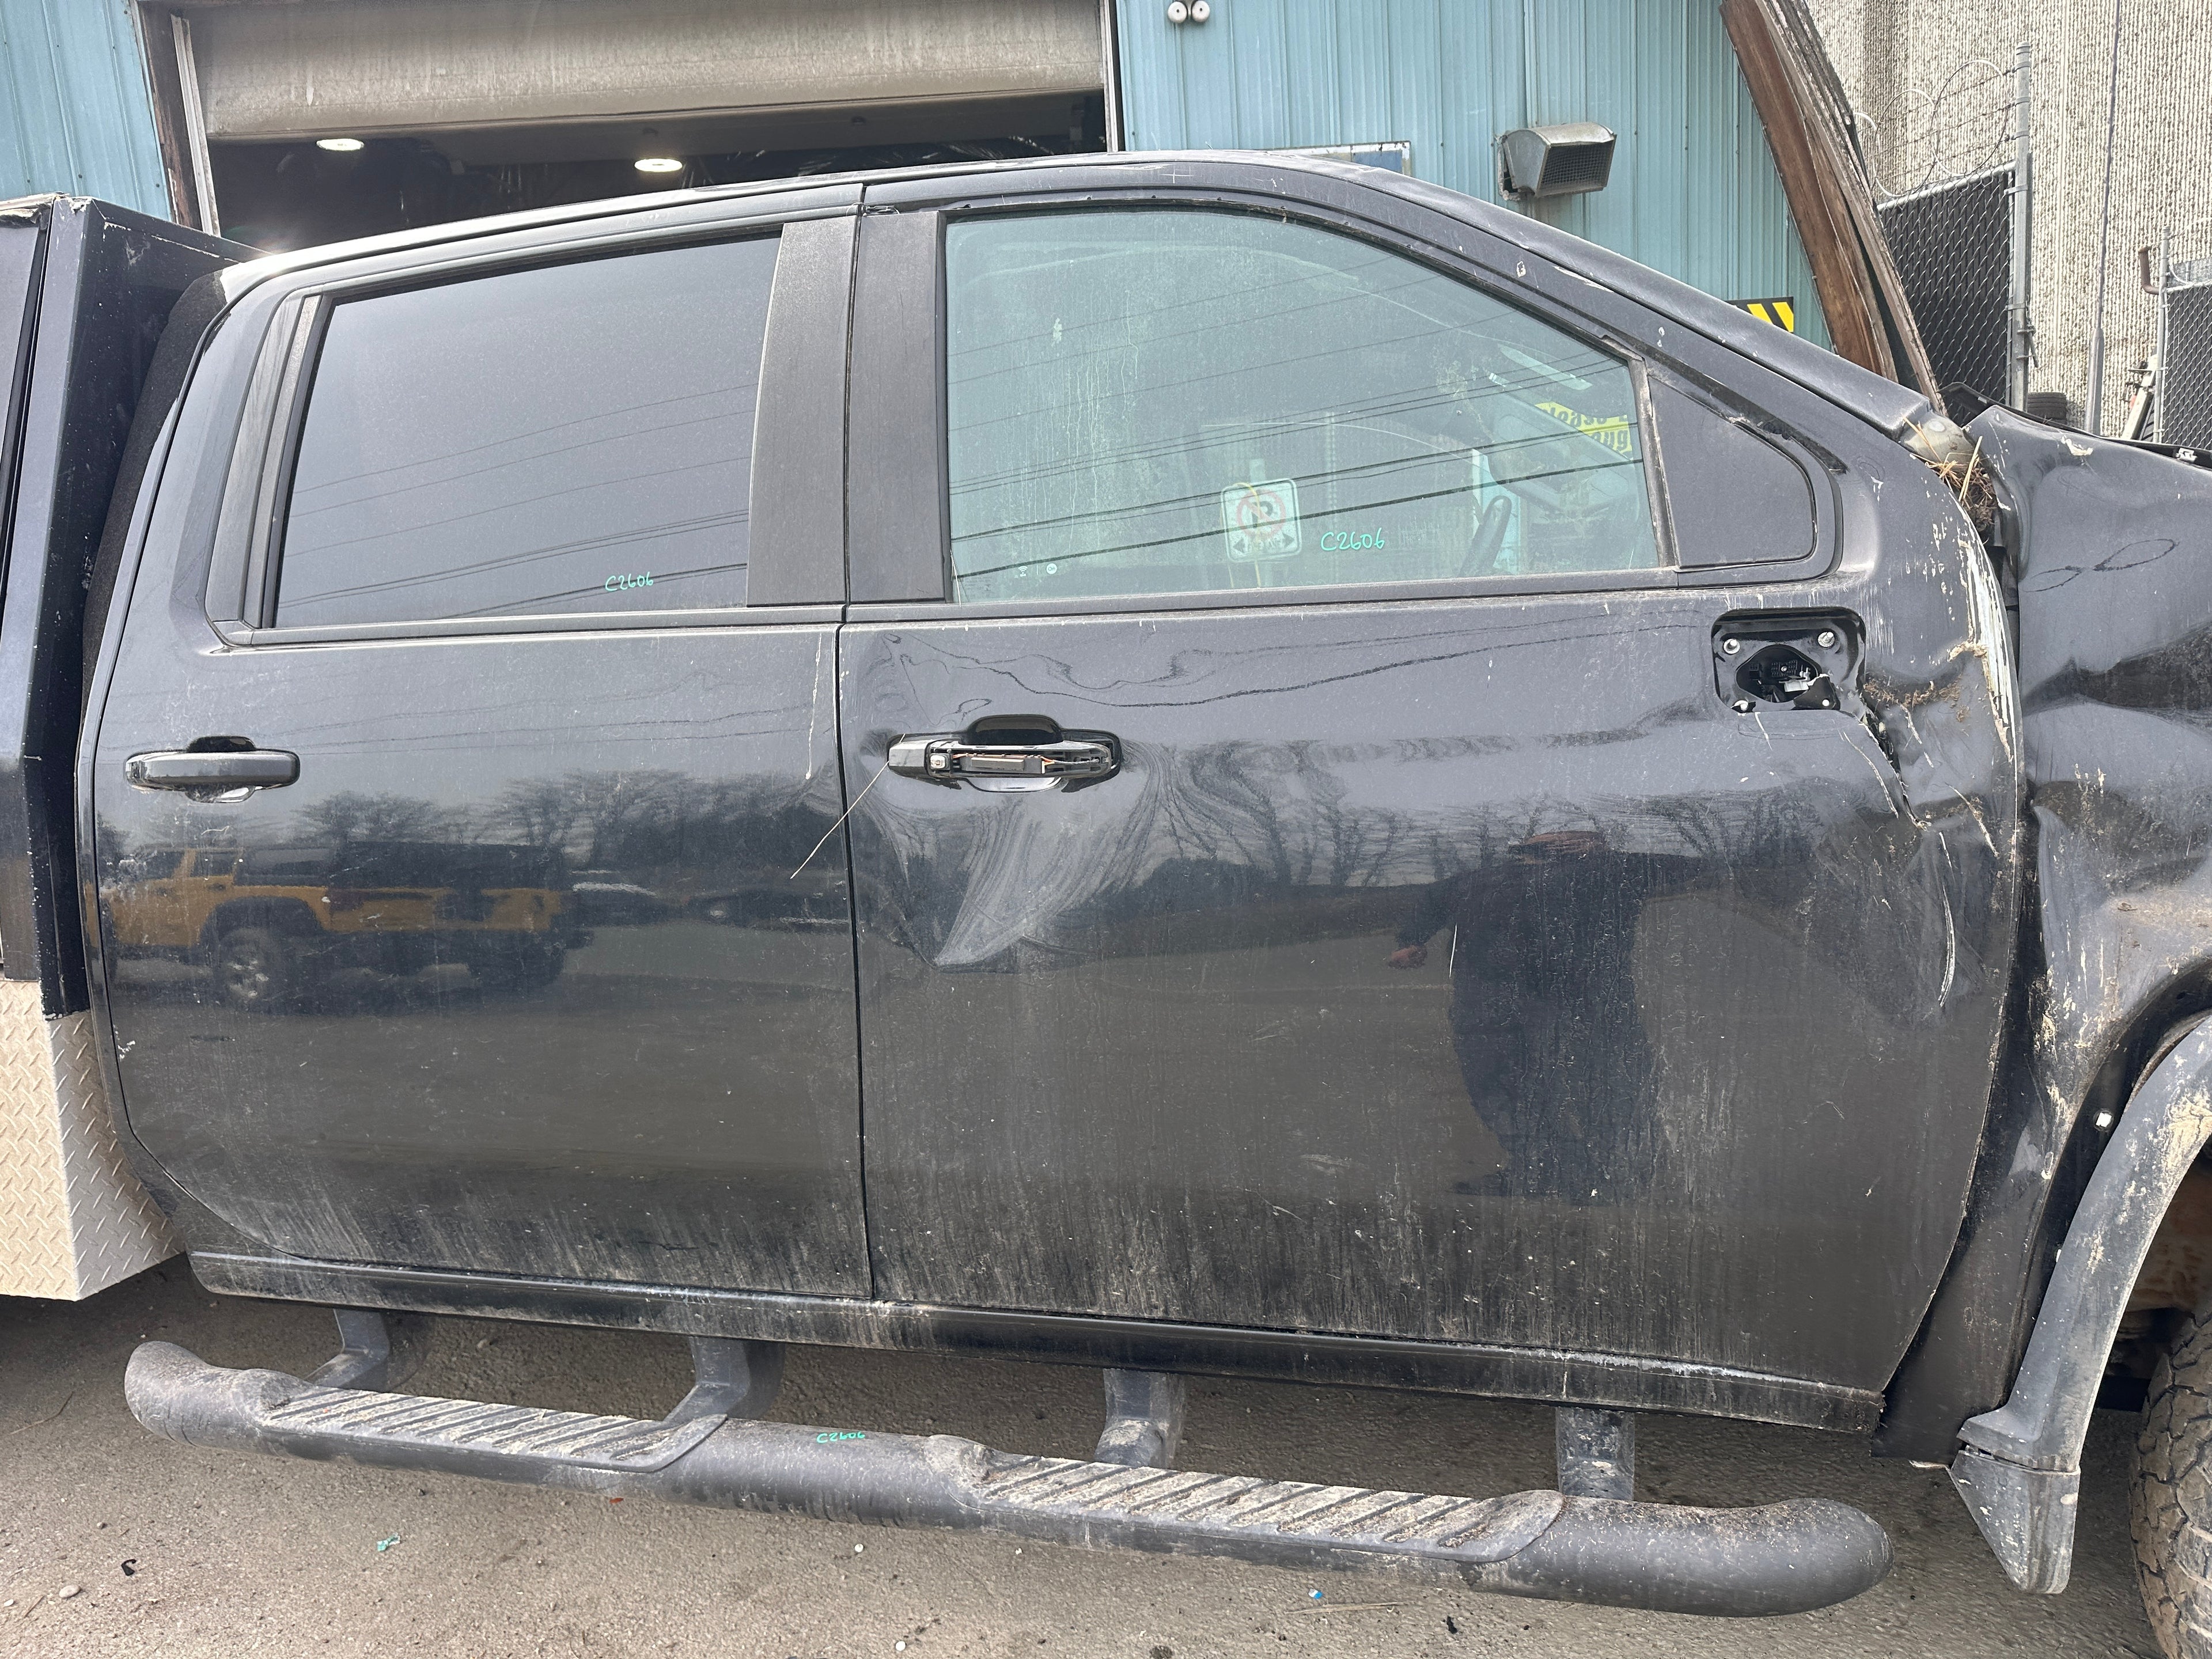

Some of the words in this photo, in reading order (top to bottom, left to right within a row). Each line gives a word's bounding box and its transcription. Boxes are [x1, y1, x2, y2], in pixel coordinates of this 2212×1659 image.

[1320, 527, 1385, 551] C2606
[605, 571, 654, 592] C2606
[816, 1431, 866, 1444] C2606
